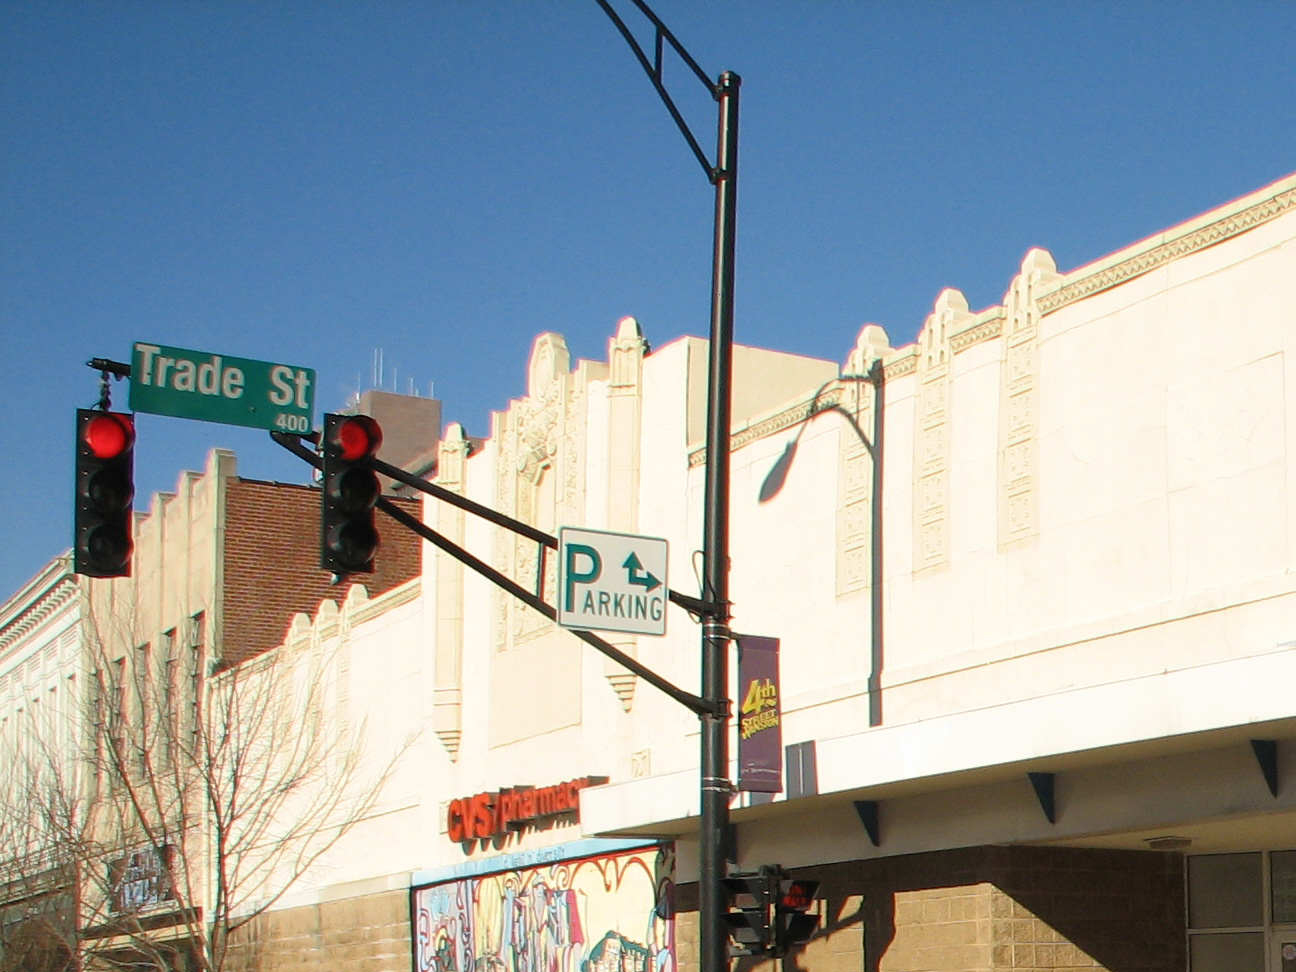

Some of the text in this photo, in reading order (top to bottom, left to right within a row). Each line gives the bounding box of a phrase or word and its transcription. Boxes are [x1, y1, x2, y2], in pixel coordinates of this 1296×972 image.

[135, 343, 310, 410] Trade St
[275, 414, 309, 432] 400
[565, 543, 662, 622] PARKING
[742, 678, 776, 714] 4th
[448, 776, 609, 843] CVS/pharmac
